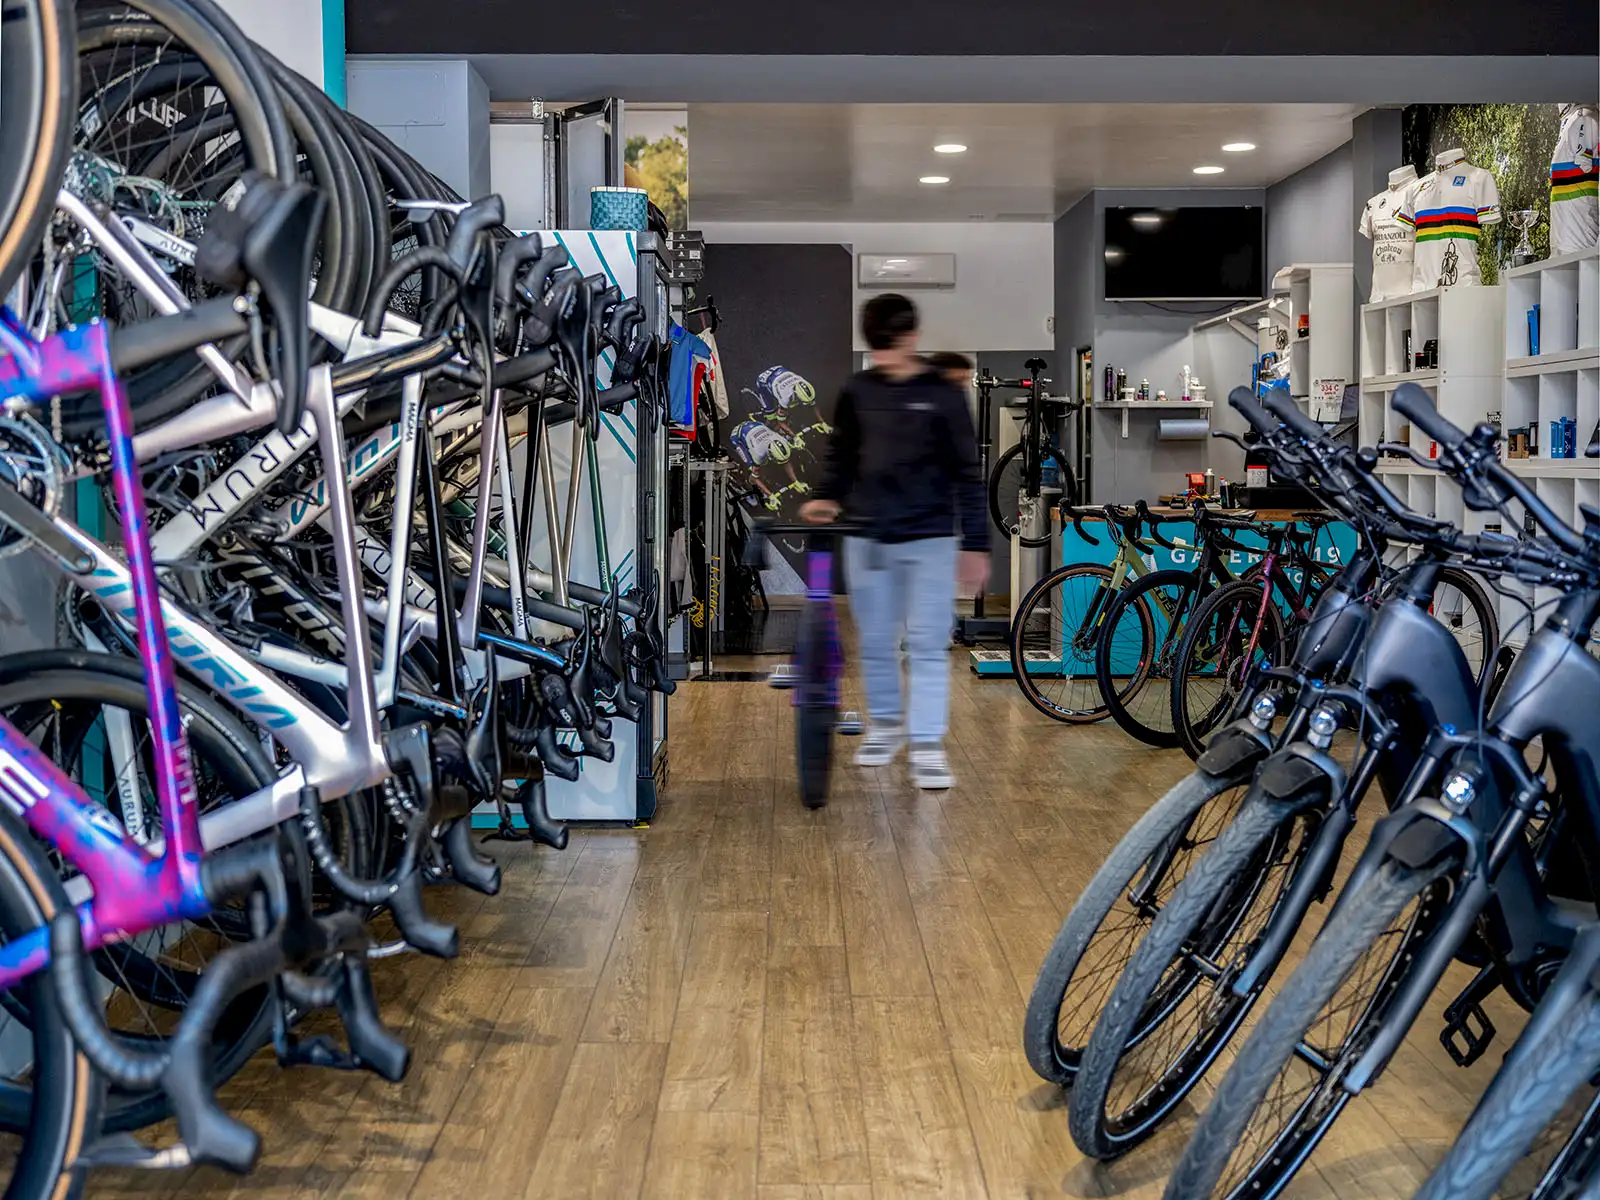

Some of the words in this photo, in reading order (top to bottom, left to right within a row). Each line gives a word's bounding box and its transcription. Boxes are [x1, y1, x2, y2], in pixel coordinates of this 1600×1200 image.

[404, 401, 417, 443] MAGMA
[1170, 548, 1296, 564] GAER
[217, 541, 348, 656] VITOR
[515, 597, 525, 628] MAGMA
